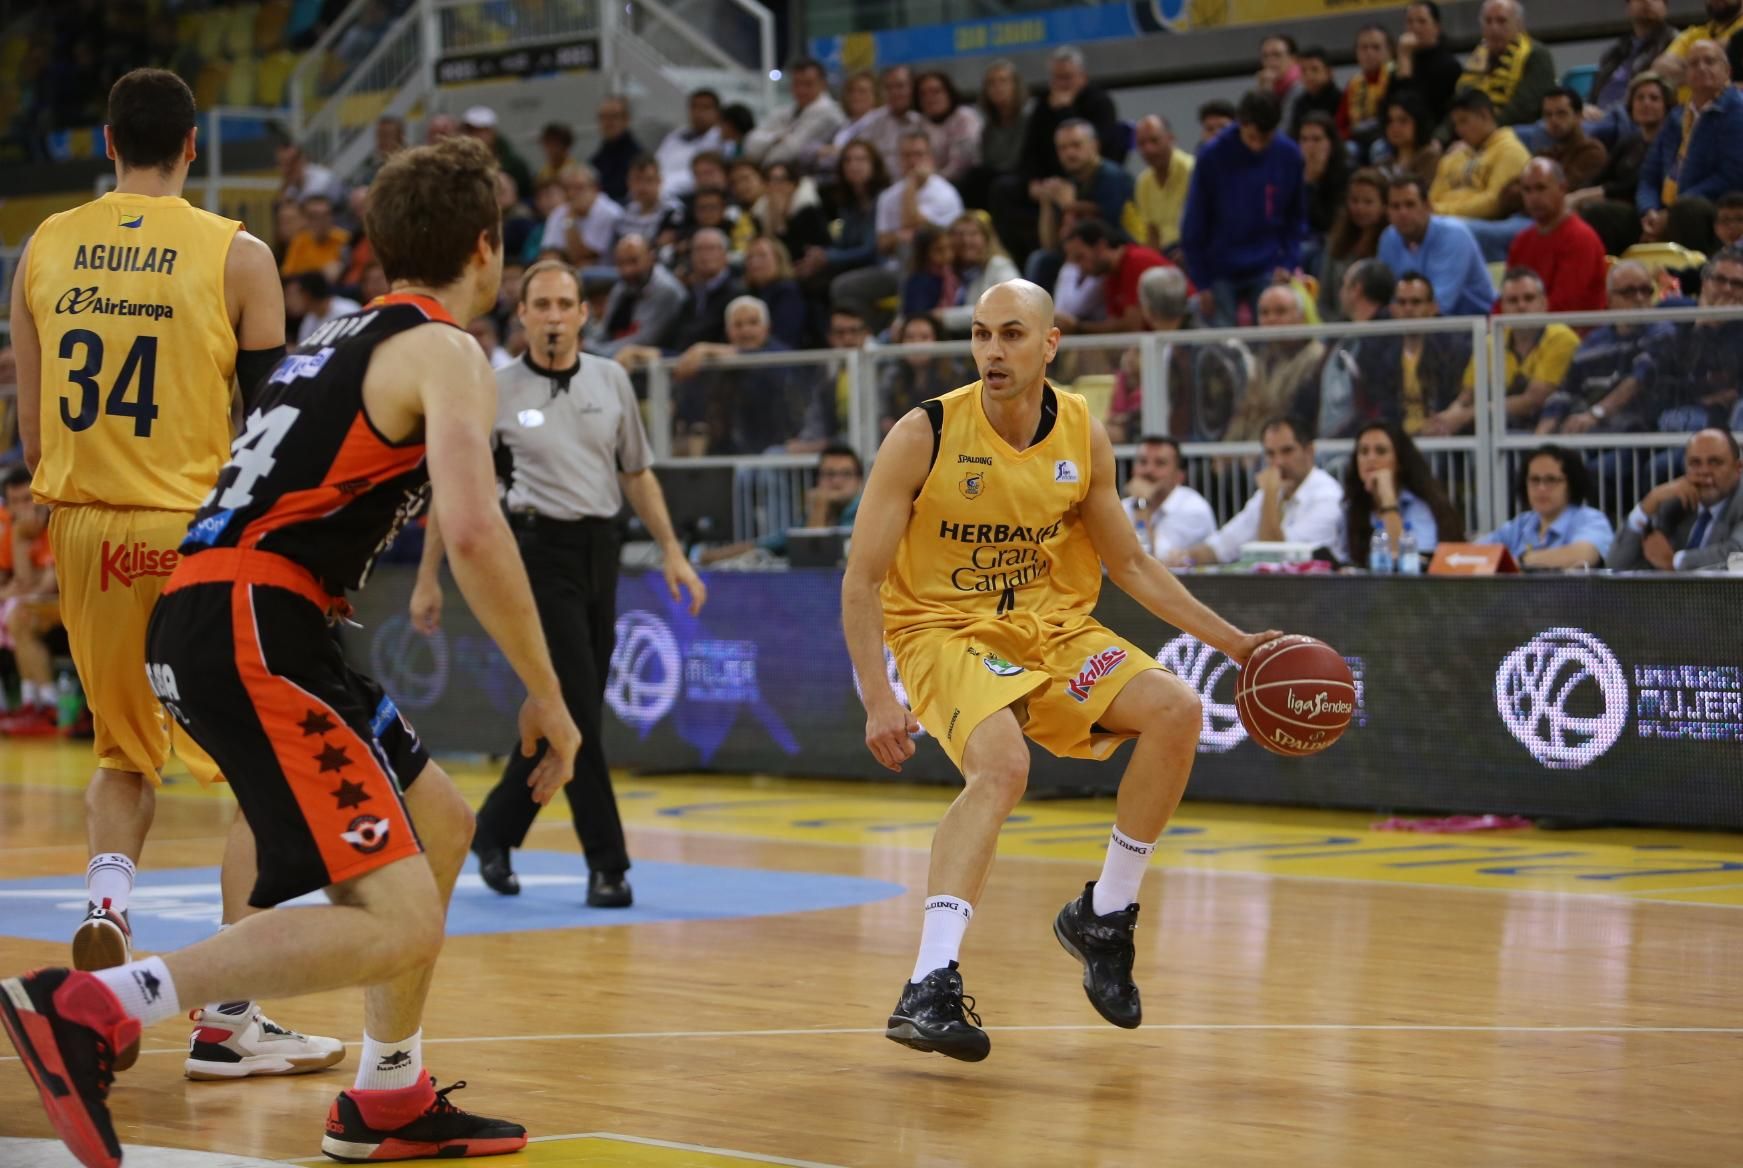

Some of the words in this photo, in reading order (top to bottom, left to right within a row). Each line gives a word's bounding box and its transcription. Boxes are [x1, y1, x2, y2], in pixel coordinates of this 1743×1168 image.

[73, 244, 178, 275] AGUILAR
[58, 328, 159, 437] 34
[201, 404, 300, 509] 4
[957, 454, 992, 466] SPALDING
[971, 545, 1038, 570] Gran
[1287, 687, 1313, 715] liga
[1270, 728, 1331, 752] SPALD
[1111, 833, 1148, 855] ALDING
